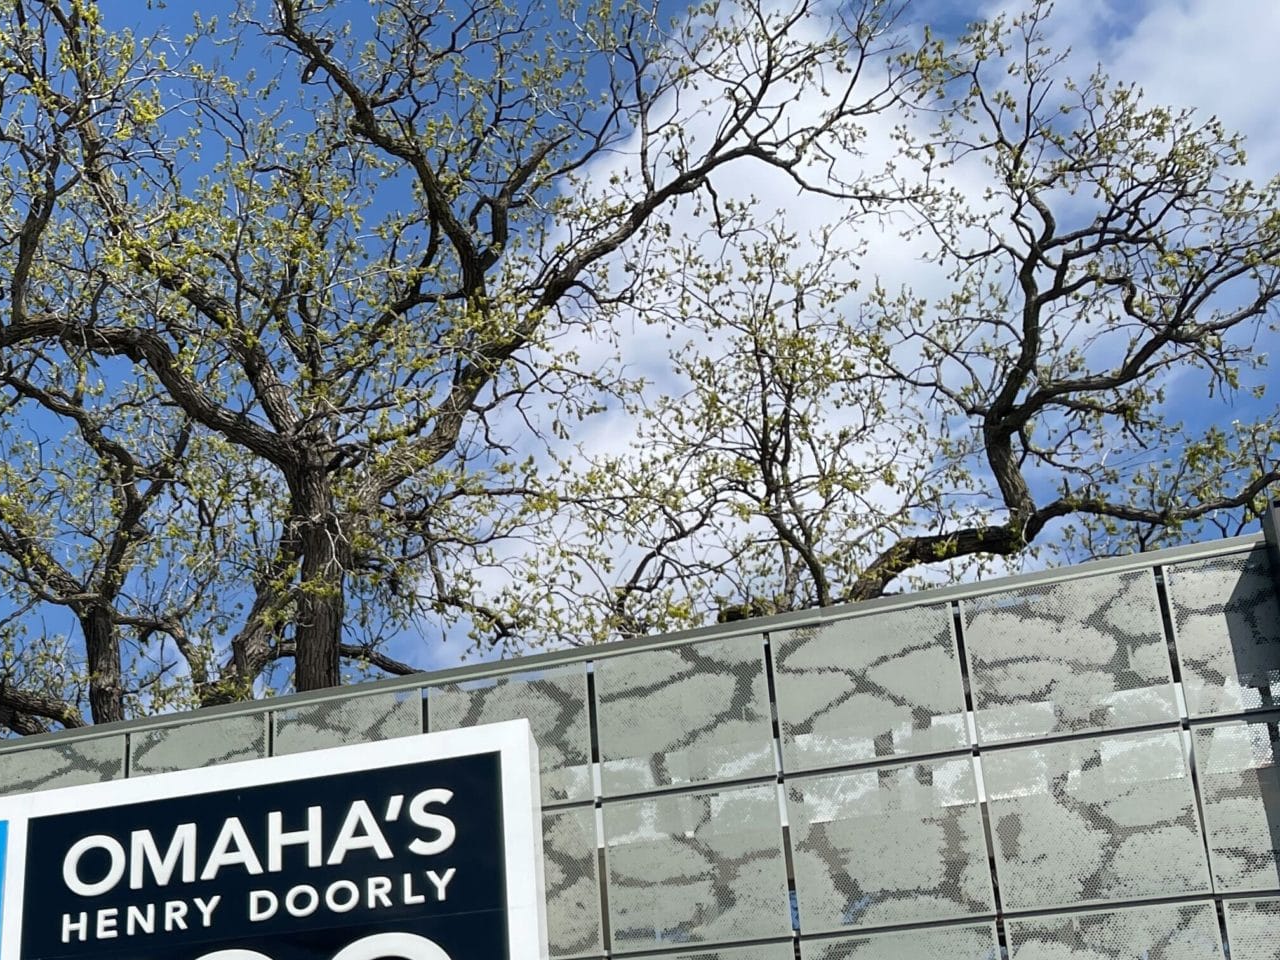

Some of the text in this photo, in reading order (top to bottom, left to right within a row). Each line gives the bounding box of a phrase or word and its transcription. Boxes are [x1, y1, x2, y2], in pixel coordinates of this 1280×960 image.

[62, 788, 457, 897] OMAHA'S
[61, 867, 457, 943] HENRY DOORLY
